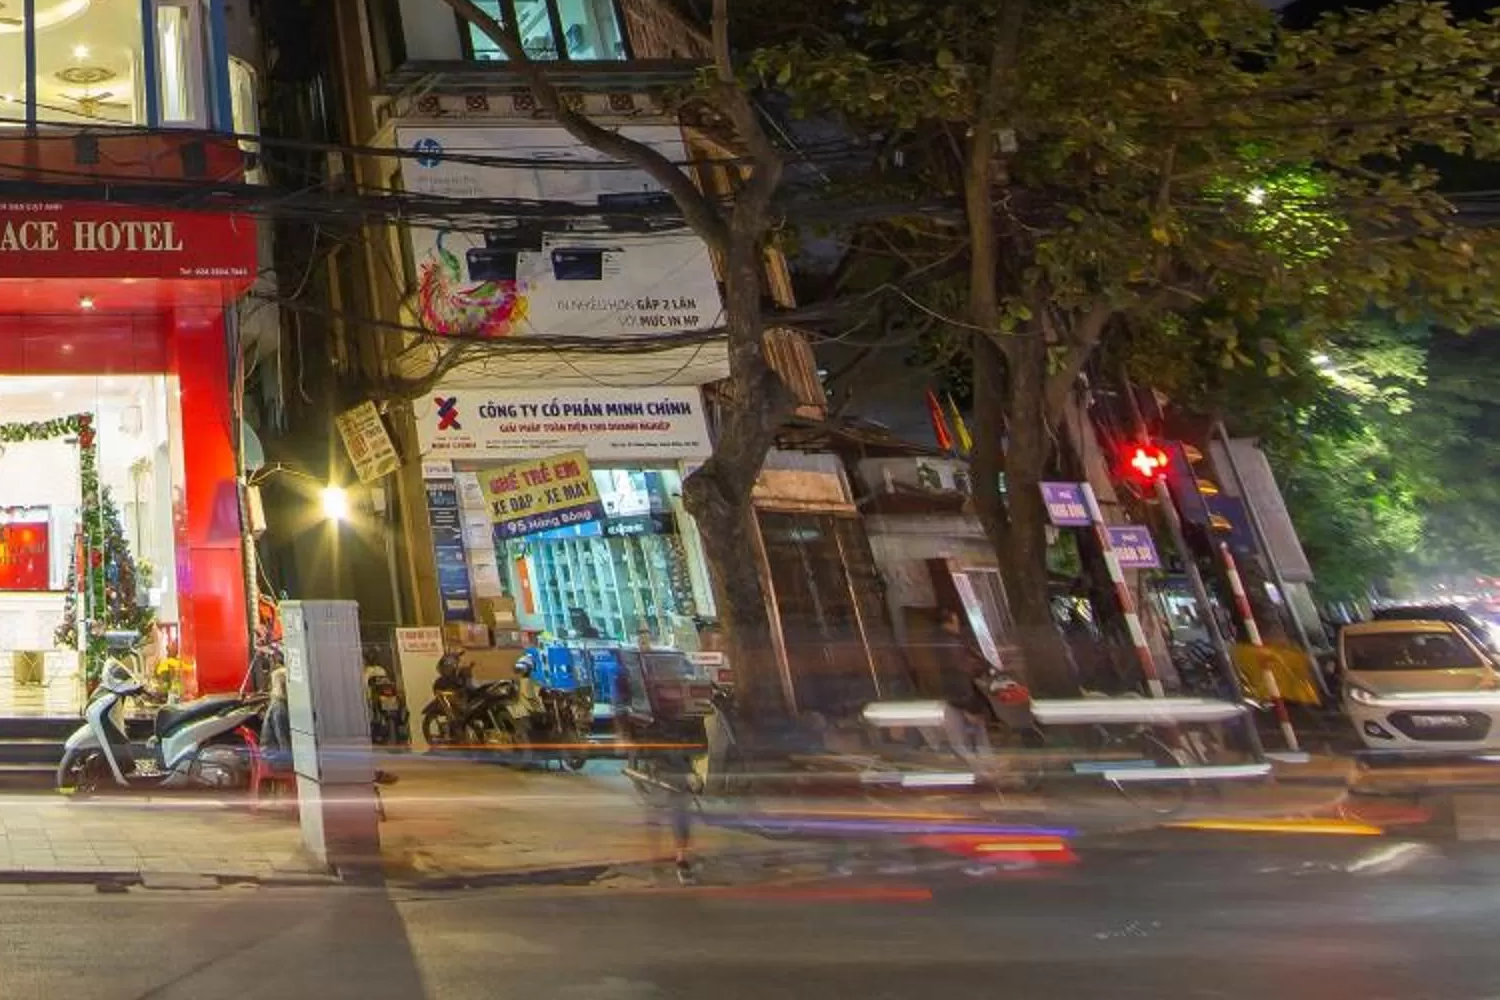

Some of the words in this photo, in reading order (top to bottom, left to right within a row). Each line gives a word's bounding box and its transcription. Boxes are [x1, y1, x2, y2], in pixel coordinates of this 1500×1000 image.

[73, 221, 183, 251] HOTEL
[479, 403, 517, 418] CÔNG
[521, 403, 538, 417] TY
[606, 402, 644, 416] MINH
[492, 499, 509, 516] XE
[544, 487, 563, 505] XE
[507, 521, 528, 534] 95
